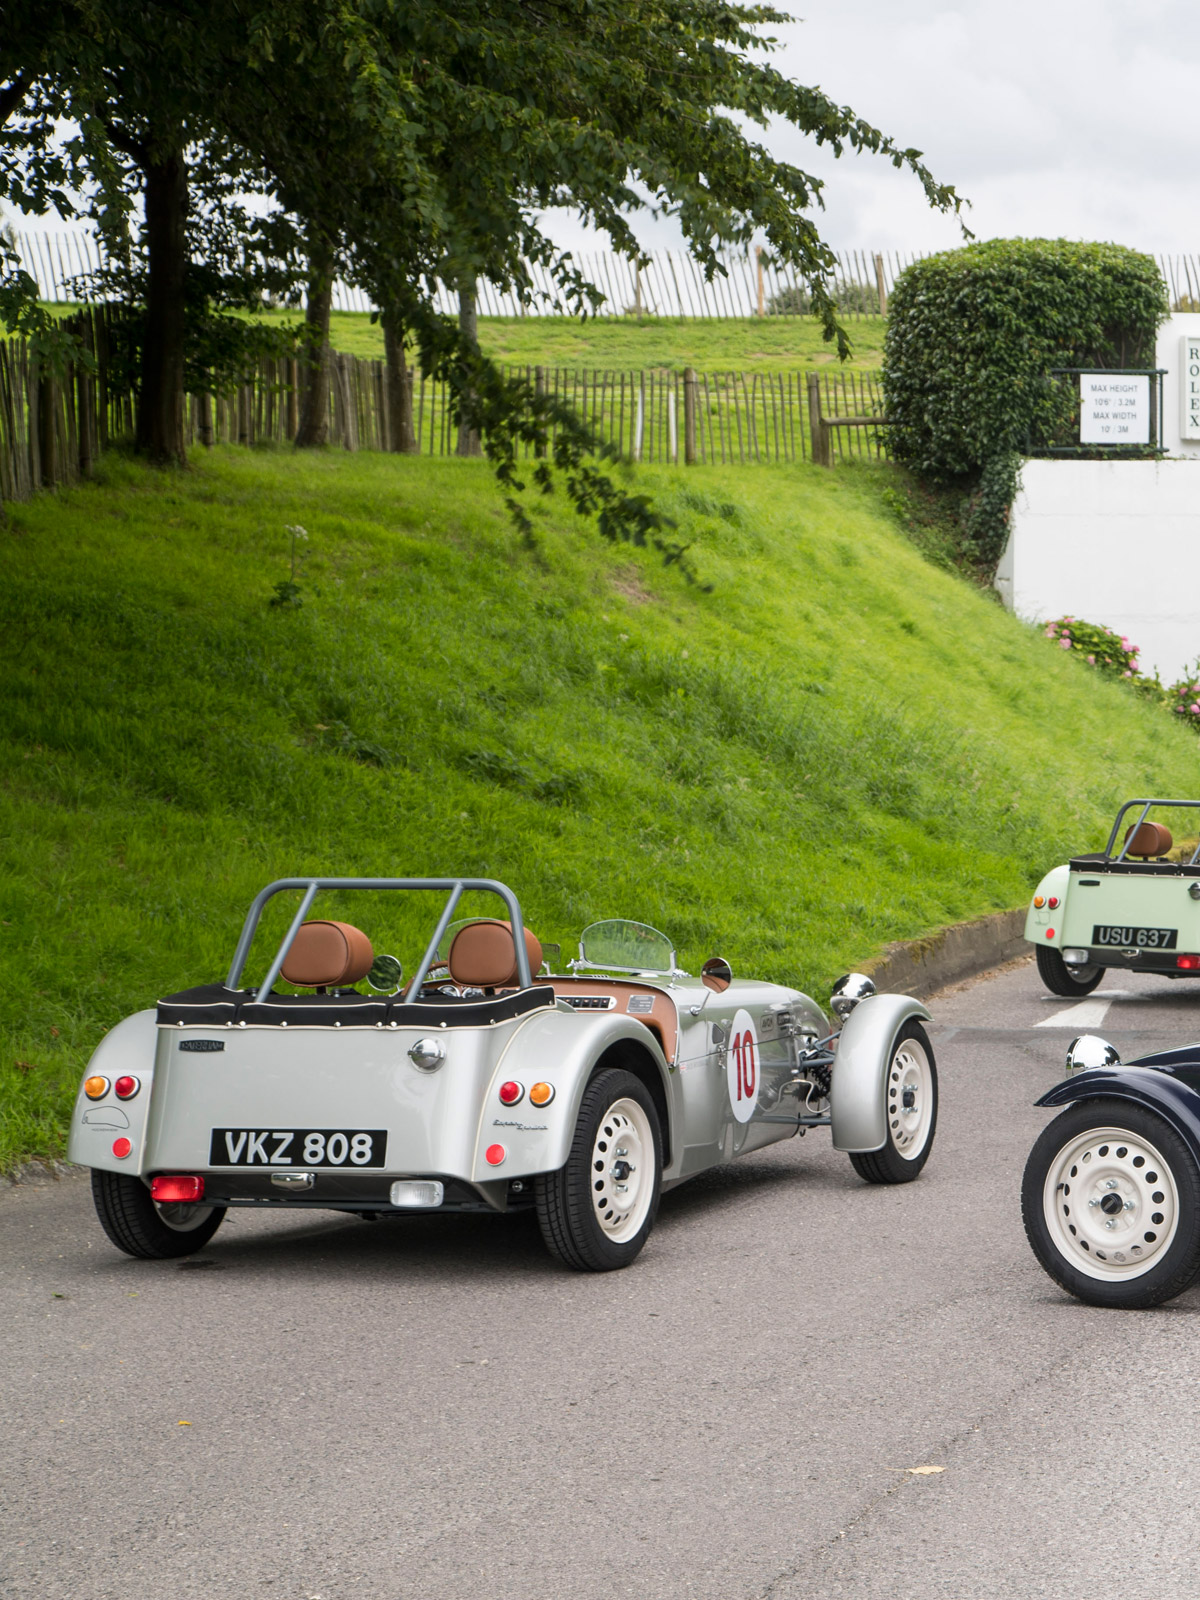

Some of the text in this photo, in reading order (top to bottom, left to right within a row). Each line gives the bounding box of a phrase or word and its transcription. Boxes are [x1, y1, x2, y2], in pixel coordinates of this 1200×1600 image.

[1090, 384, 1138, 393] MAX HEIGHT
[1189, 347, 1200, 427] ROLEX
[1112, 411, 1137, 419] WIDTH
[1098, 927, 1171, 947] USU 637
[732, 1029, 756, 1102] 10
[225, 1131, 373, 1165] VKZ 808
